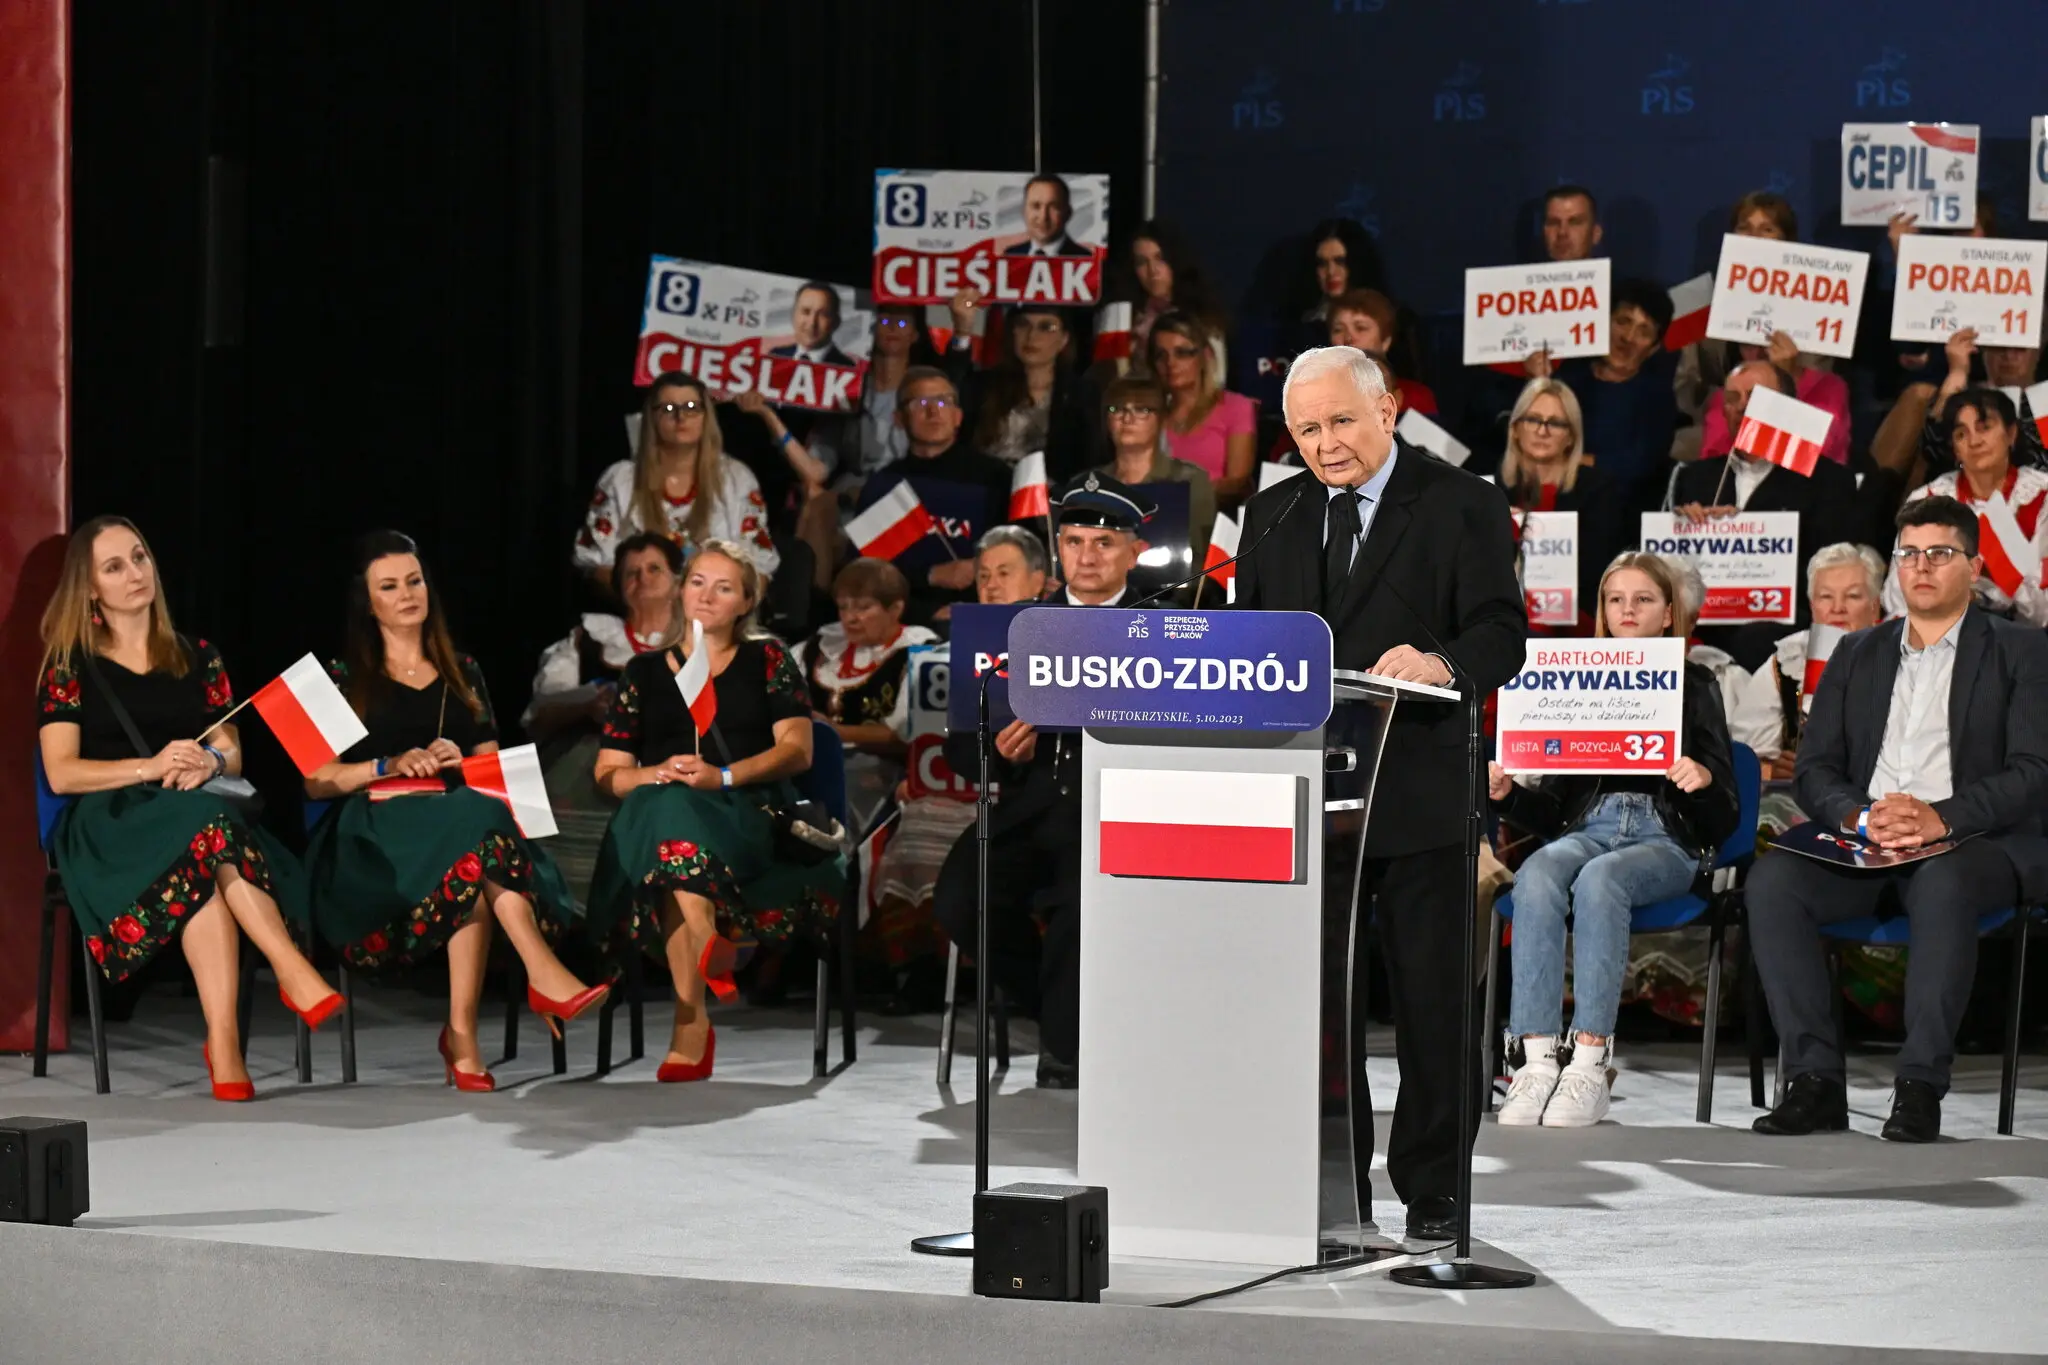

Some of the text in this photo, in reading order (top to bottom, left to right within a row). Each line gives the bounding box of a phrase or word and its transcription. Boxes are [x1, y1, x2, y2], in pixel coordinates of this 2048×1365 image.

[1848, 144, 1935, 190] CEPIL
[893, 186, 920, 226] 8
[954, 208, 991, 230] PiS
[883, 251, 1093, 301] CIEŚLAK
[1727, 264, 1849, 306] PORADA
[1908, 263, 2032, 296] PORADA
[664, 275, 692, 313] 8
[724, 305, 761, 328] PiS
[1476, 285, 1599, 319] PORADA
[1569, 322, 1595, 345] 11
[1816, 317, 1843, 344] 11
[2000, 309, 2028, 334] 11
[647, 342, 857, 407] CIEŚLAK
[1645, 538, 1793, 554] DORYWALSKI
[1531, 591, 1564, 613] 32
[1748, 589, 1783, 612] 32
[1128, 624, 1149, 638] PiS
[1164, 616, 1208, 624] BEZPIECZNA
[1164, 622, 1210, 632] PRZYSZŁOŚĆ
[1537, 651, 1644, 666] BARTŁOMIEJ
[1028, 652, 1309, 692] BUSKO-ZDRÓJ
[1504, 671, 1677, 691] DORYWALSKI
[1195, 713, 1243, 725] 5.10.2023
[1511, 742, 1539, 753] LISTA
[1570, 742, 1622, 753] POZYCJA
[1623, 734, 1667, 761] 32
